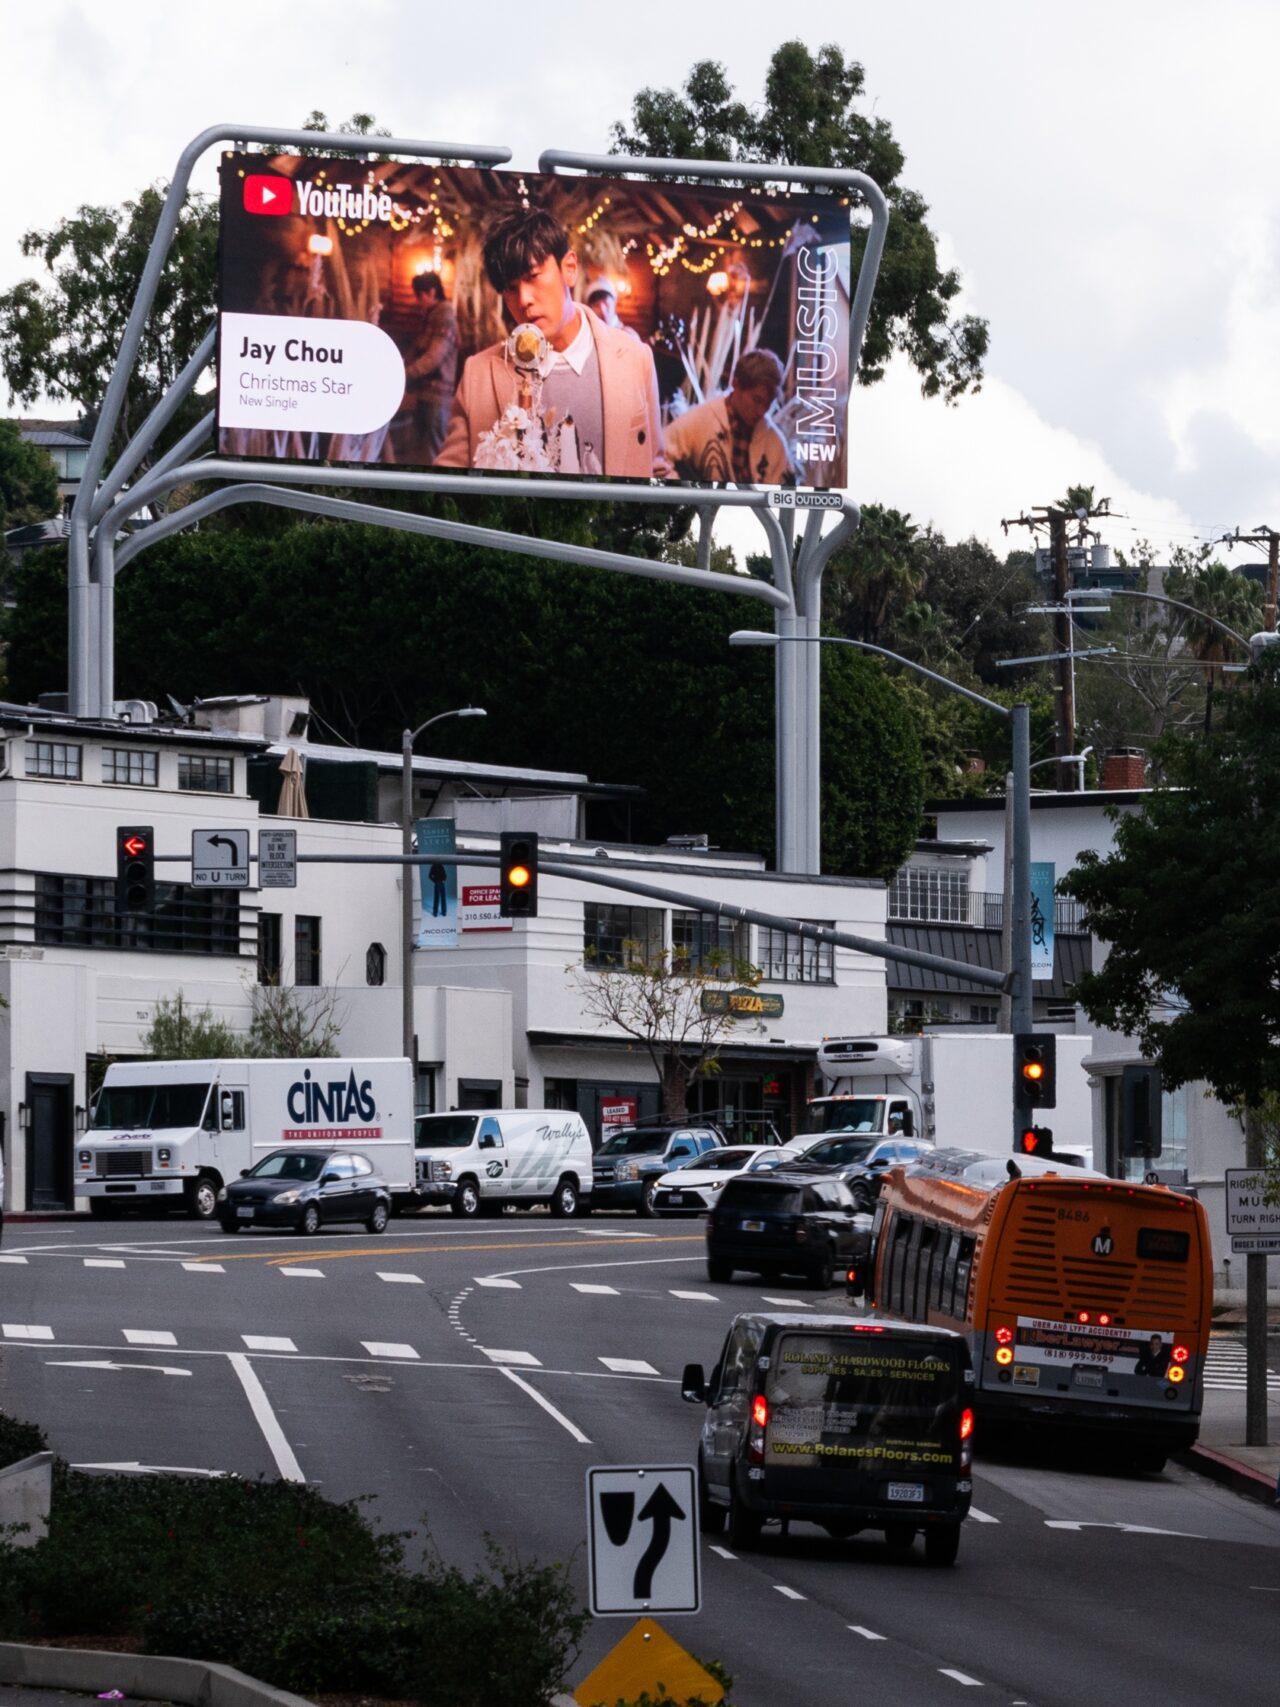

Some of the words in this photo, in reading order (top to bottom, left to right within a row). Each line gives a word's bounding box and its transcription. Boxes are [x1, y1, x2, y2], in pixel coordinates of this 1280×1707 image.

[296, 181, 392, 221] YouTube
[796, 246, 838, 437] MUSIC
[240, 336, 276, 365] Jay
[285, 339, 343, 364] Chou
[239, 372, 317, 393] Christmas
[322, 376, 353, 395] Star
[239, 394, 263, 407] New
[266, 396, 298, 411] Single
[796, 443, 836, 462] NEW
[774, 493, 792, 504] BIG
[796, 496, 841, 506] OUTDOOR
[211, 872, 220, 882] U
[225, 873, 246, 881] TURN
[307, 1130, 343, 1138] UNIFORM
[347, 1129, 377, 1137] PEOPLE
[536, 1120, 585, 1155] Wally's
[1057, 1208, 1090, 1223] 8486
[1231, 1215, 1256, 1223] TURN
[1094, 1237, 1112, 1254] M
[1032, 1320, 1051, 1329] UBER
[1053, 1322, 1068, 1331] AND
[1070, 1324, 1086, 1332] LYFT
[783, 1352, 838, 1365] ROLAND'S
[840, 1355, 905, 1369] HARDWOOD
[908, 1359, 951, 1372] FLOORS
[890, 1371, 936, 1381] SERVICES
[773, 1443, 953, 1464] www.RolandsFloors.com
